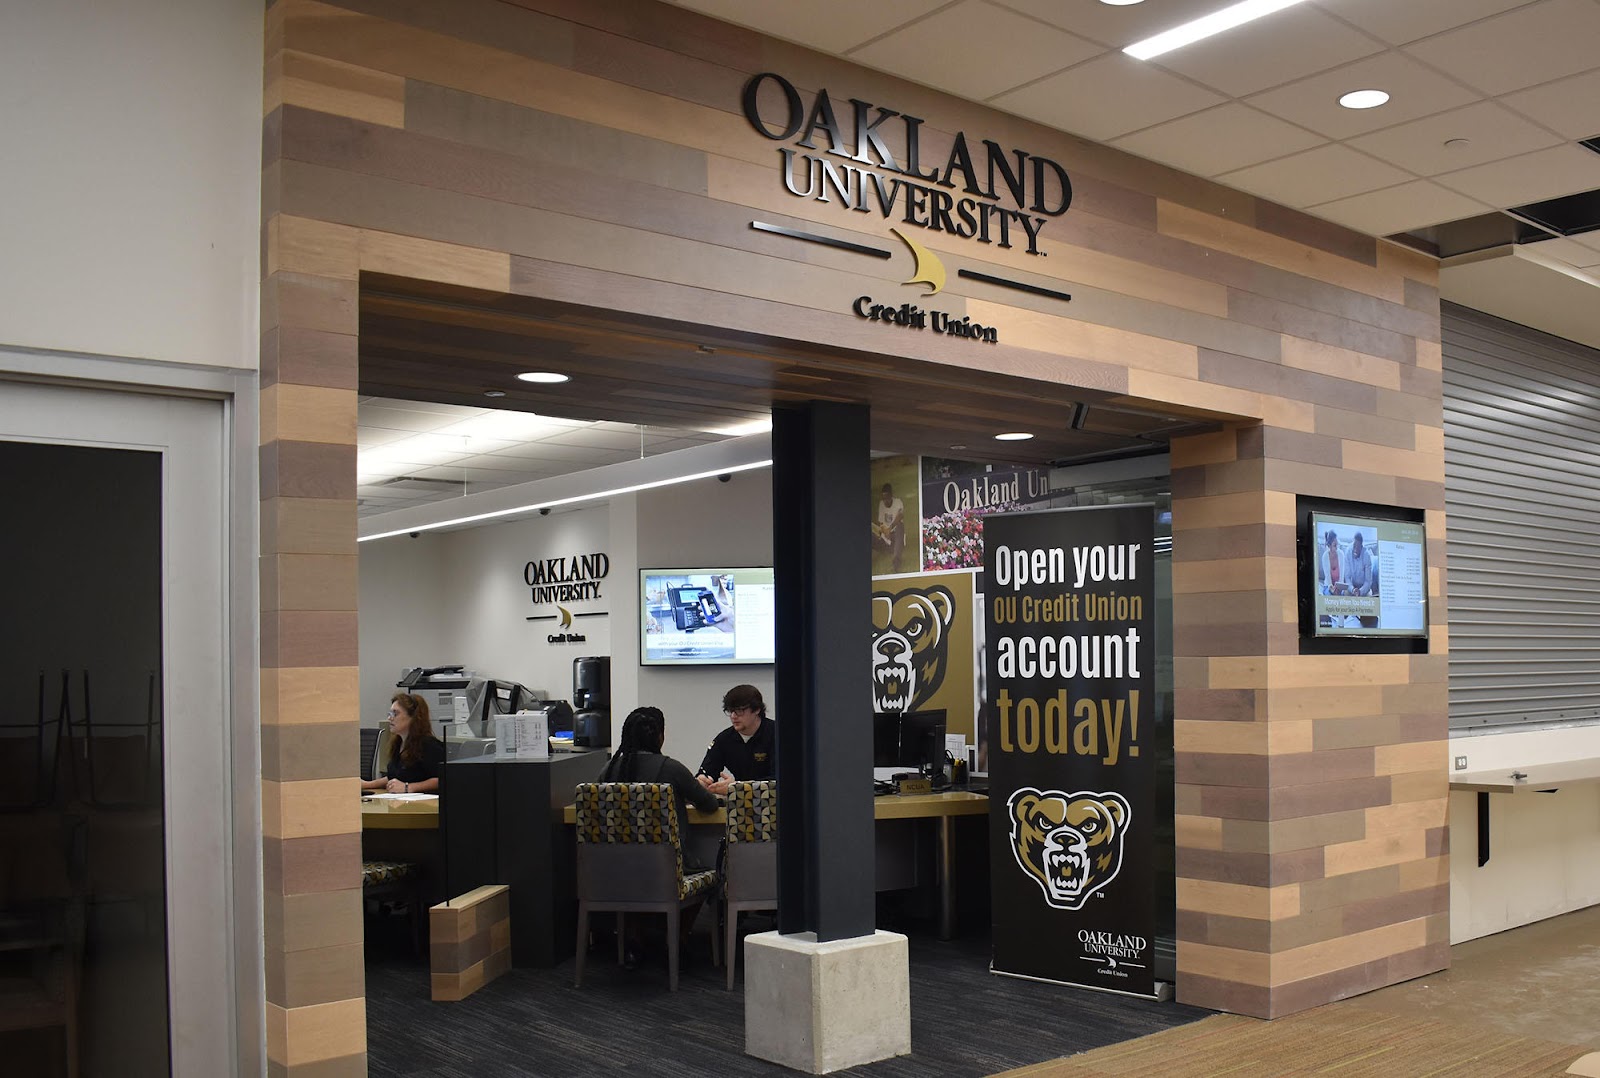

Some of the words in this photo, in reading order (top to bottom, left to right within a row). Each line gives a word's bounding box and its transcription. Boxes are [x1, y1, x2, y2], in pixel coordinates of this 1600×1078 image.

[743, 72, 1073, 217] OAKLAND
[779, 148, 1047, 256] UNIVERSITY
[853, 296, 927, 330] Credit
[930, 310, 998, 344] Union
[943, 472, 1020, 514] Oakland
[524, 553, 609, 586] OAKLAND
[995, 545, 1065, 591] Open
[1072, 543, 1141, 589] your
[531, 581, 600, 604] UNIVERSITY
[993, 596, 1017, 624] OU
[1022, 592, 1080, 623] Credit
[1084, 591, 1143, 622] Union
[547, 633, 566, 643] Credit
[566, 633, 586, 643] Union
[997, 627, 1141, 679] account
[996, 688, 1140, 766] today!
[1077, 929, 1147, 951] OAKLAND
[1084, 943, 1140, 959] UNIVERSITY
[1113, 969, 1128, 978] Union
